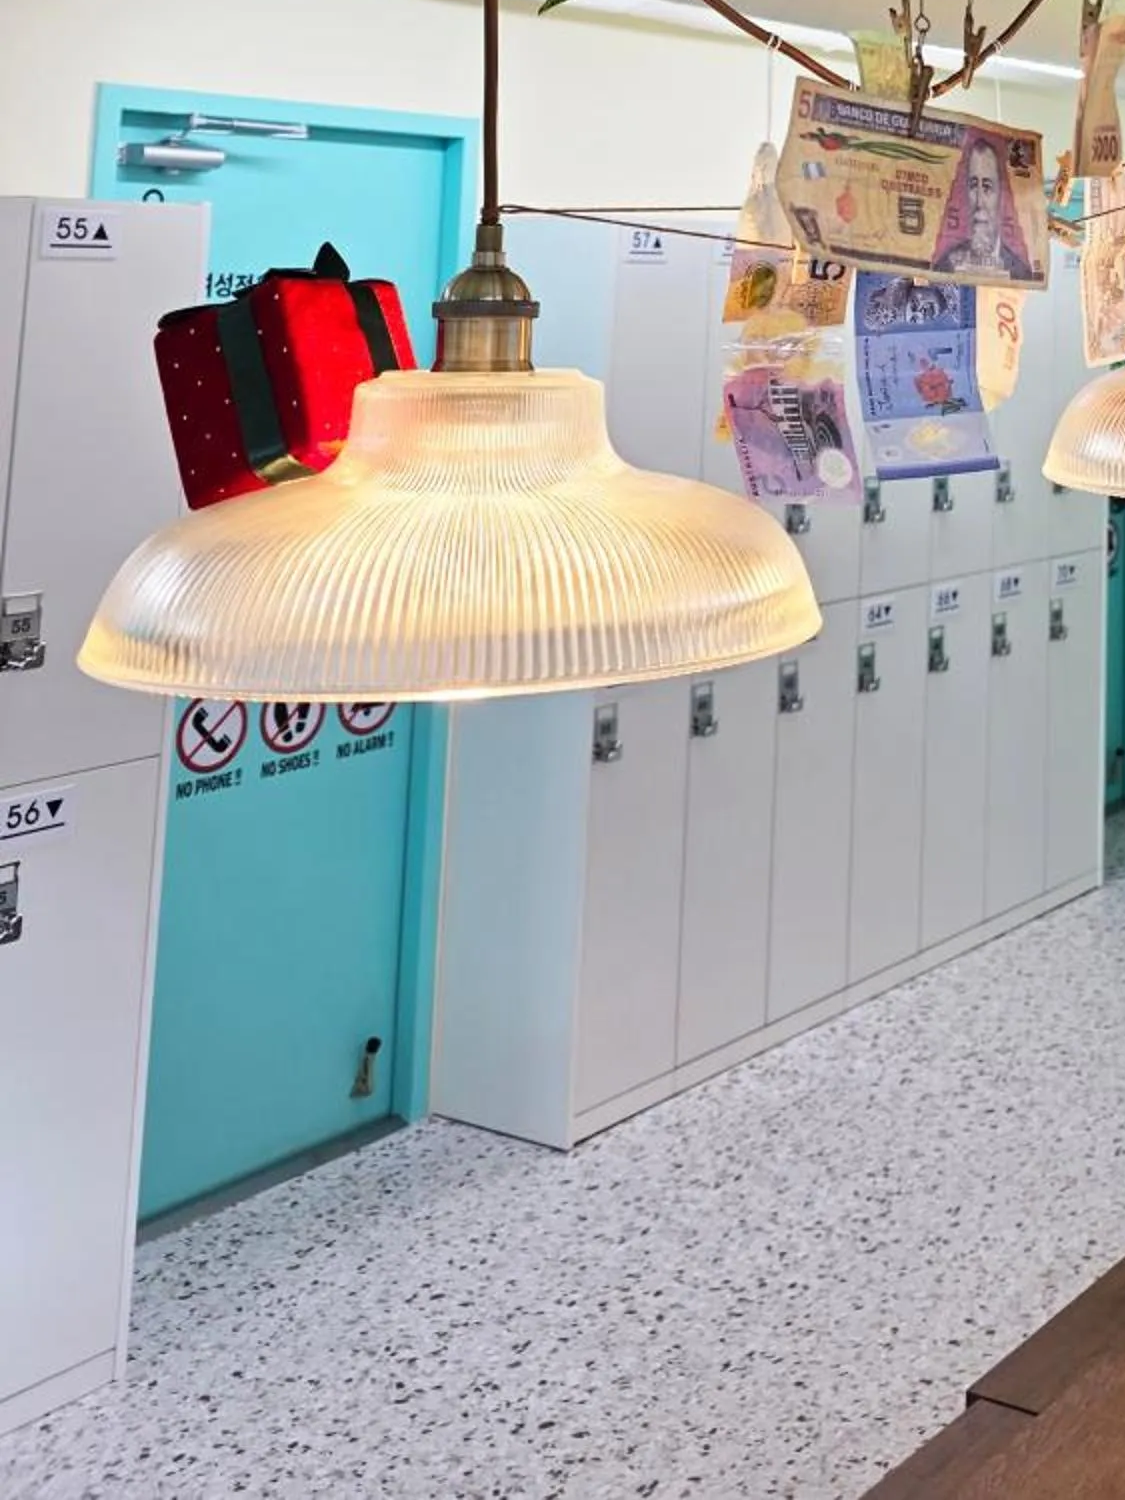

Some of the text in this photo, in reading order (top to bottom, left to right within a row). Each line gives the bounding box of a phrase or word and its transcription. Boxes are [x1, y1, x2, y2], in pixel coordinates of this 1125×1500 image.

[798, 90, 812, 119] 5
[837, 103, 873, 121] BANCO
[875, 109, 889, 125] DE
[56, 217, 88, 240] 55
[633, 231, 651, 249] 57
[335, 743, 350, 758] NO
[352, 734, 386, 756] ALARM
[260, 762, 277, 779] NO
[278, 753, 311, 775] SHOES
[175, 782, 192, 800] NO
[194, 770, 232, 796] PHONE
[6, 799, 40, 829] 56
